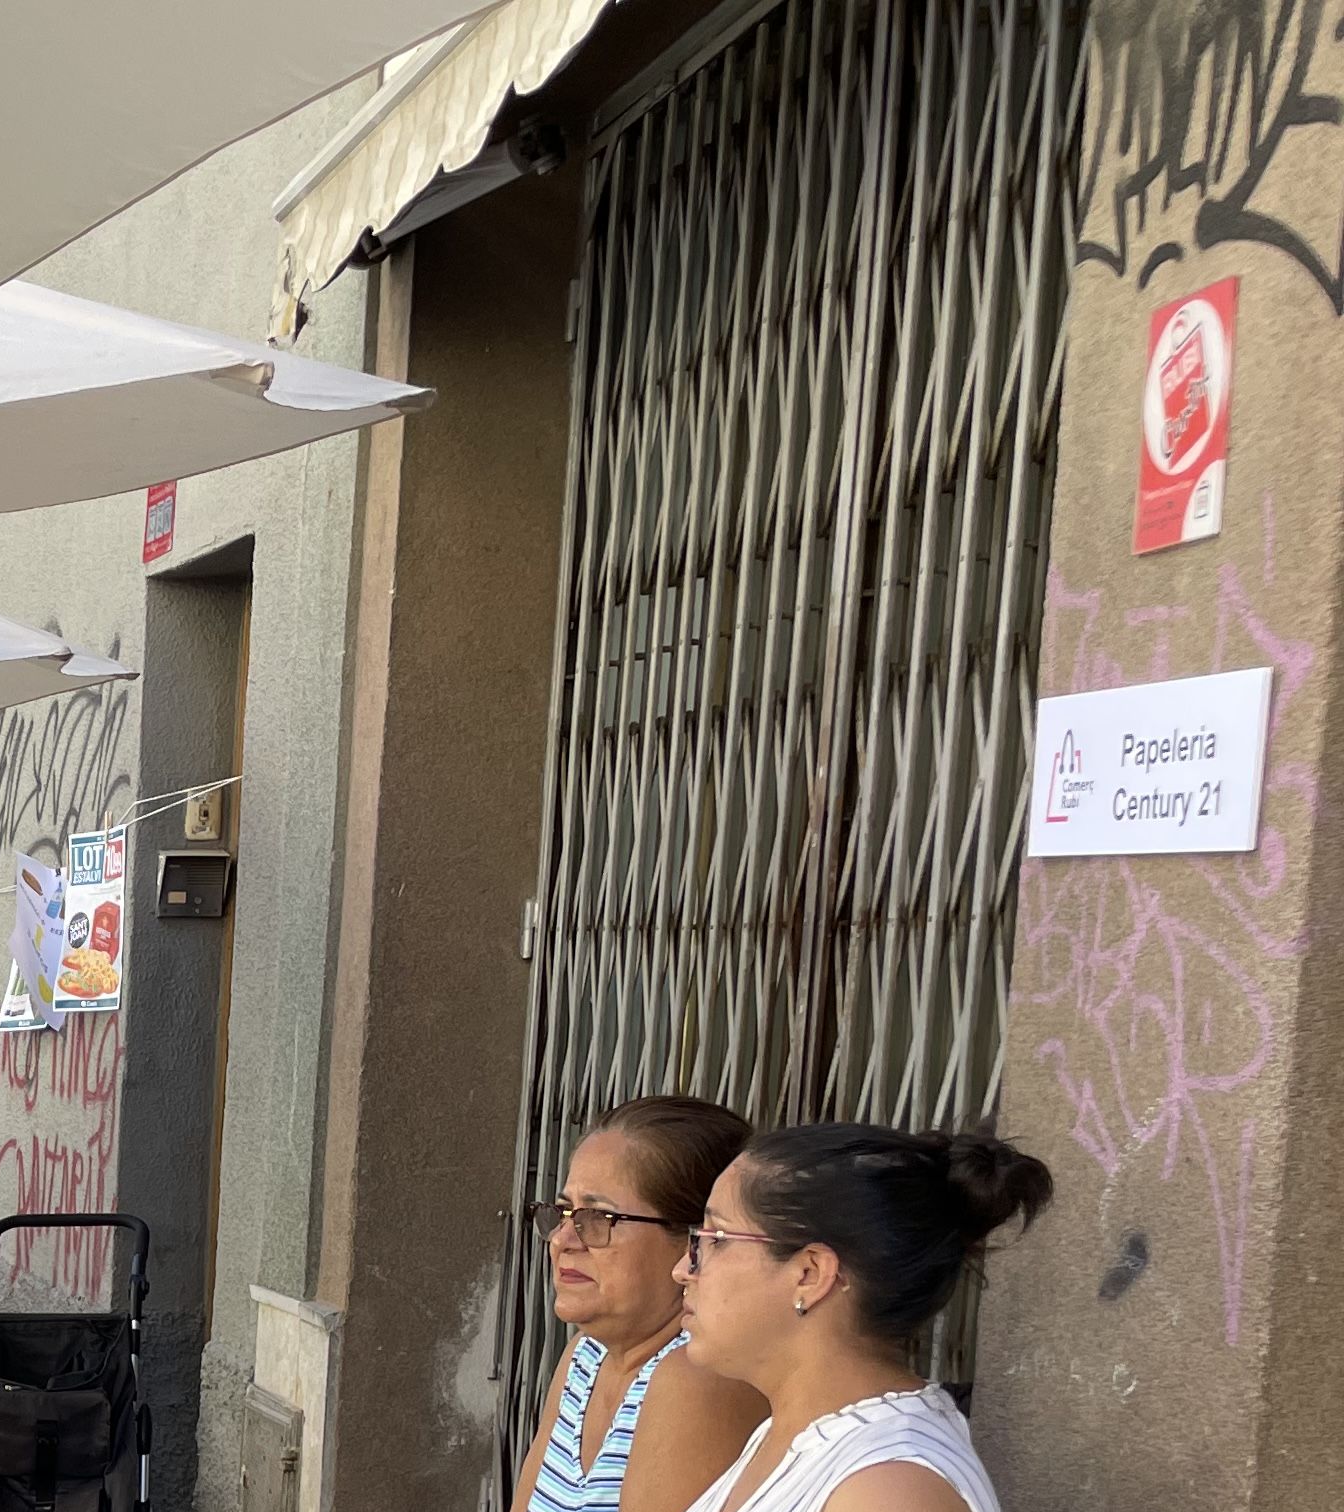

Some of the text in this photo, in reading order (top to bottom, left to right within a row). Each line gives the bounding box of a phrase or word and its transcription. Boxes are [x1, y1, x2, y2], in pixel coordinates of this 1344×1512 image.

[1112, 780, 1223, 827] Century 21
[74, 845, 104, 871] LOT
[70, 918, 88, 932] SANT
